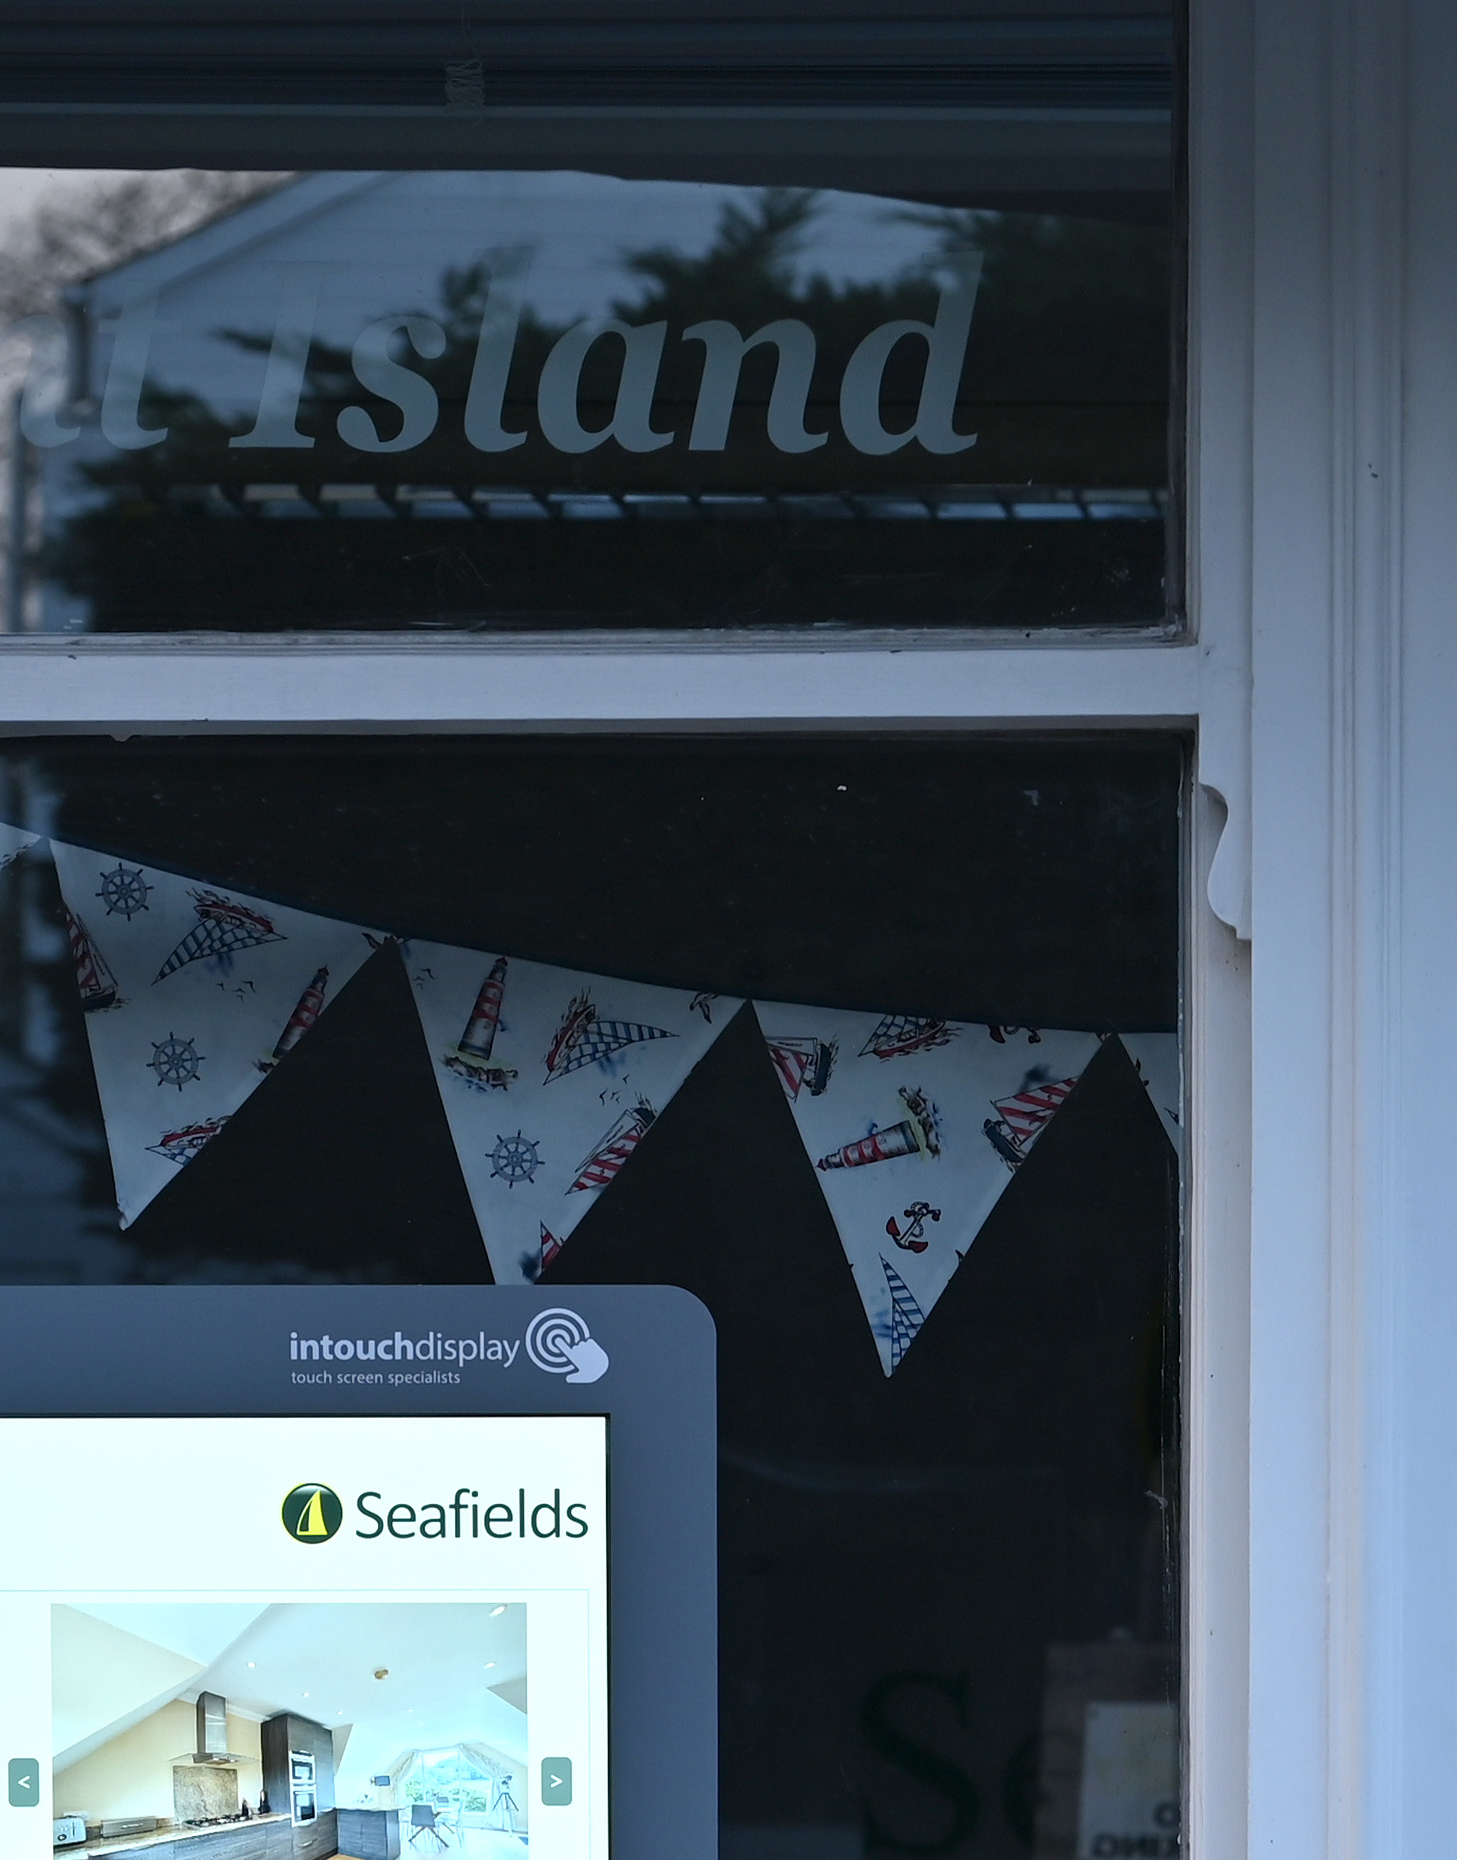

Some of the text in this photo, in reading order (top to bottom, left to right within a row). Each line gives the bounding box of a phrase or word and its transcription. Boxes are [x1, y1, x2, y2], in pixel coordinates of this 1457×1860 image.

[227, 246, 980, 455] Island
[289, 1330, 521, 1368] intouchdisplay
[290, 1369, 461, 1387] touch screen specialists
[355, 1487, 589, 1539] Seafields
